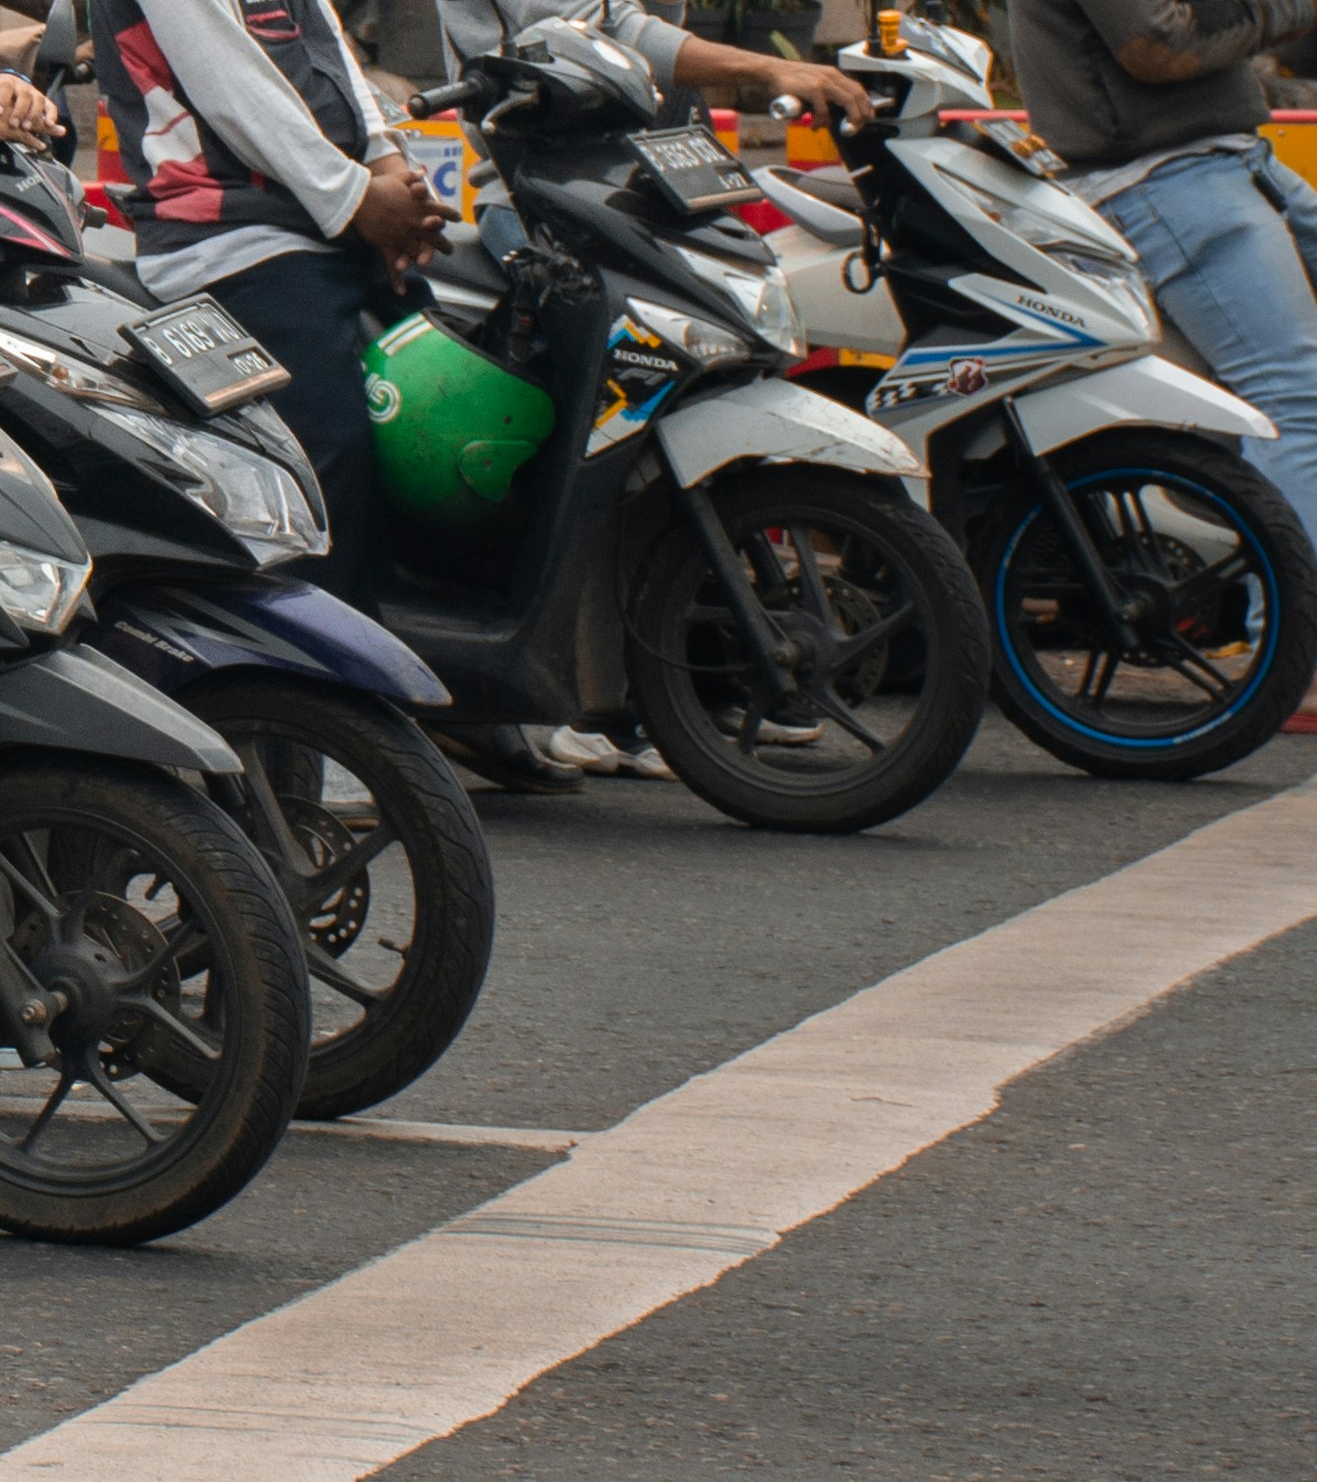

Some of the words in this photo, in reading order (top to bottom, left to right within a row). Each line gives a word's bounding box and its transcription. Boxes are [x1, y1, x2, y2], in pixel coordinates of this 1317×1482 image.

[1017, 295, 1087, 328] HONDA
[144, 337, 173, 366] B
[613, 349, 679, 371] HONDA
